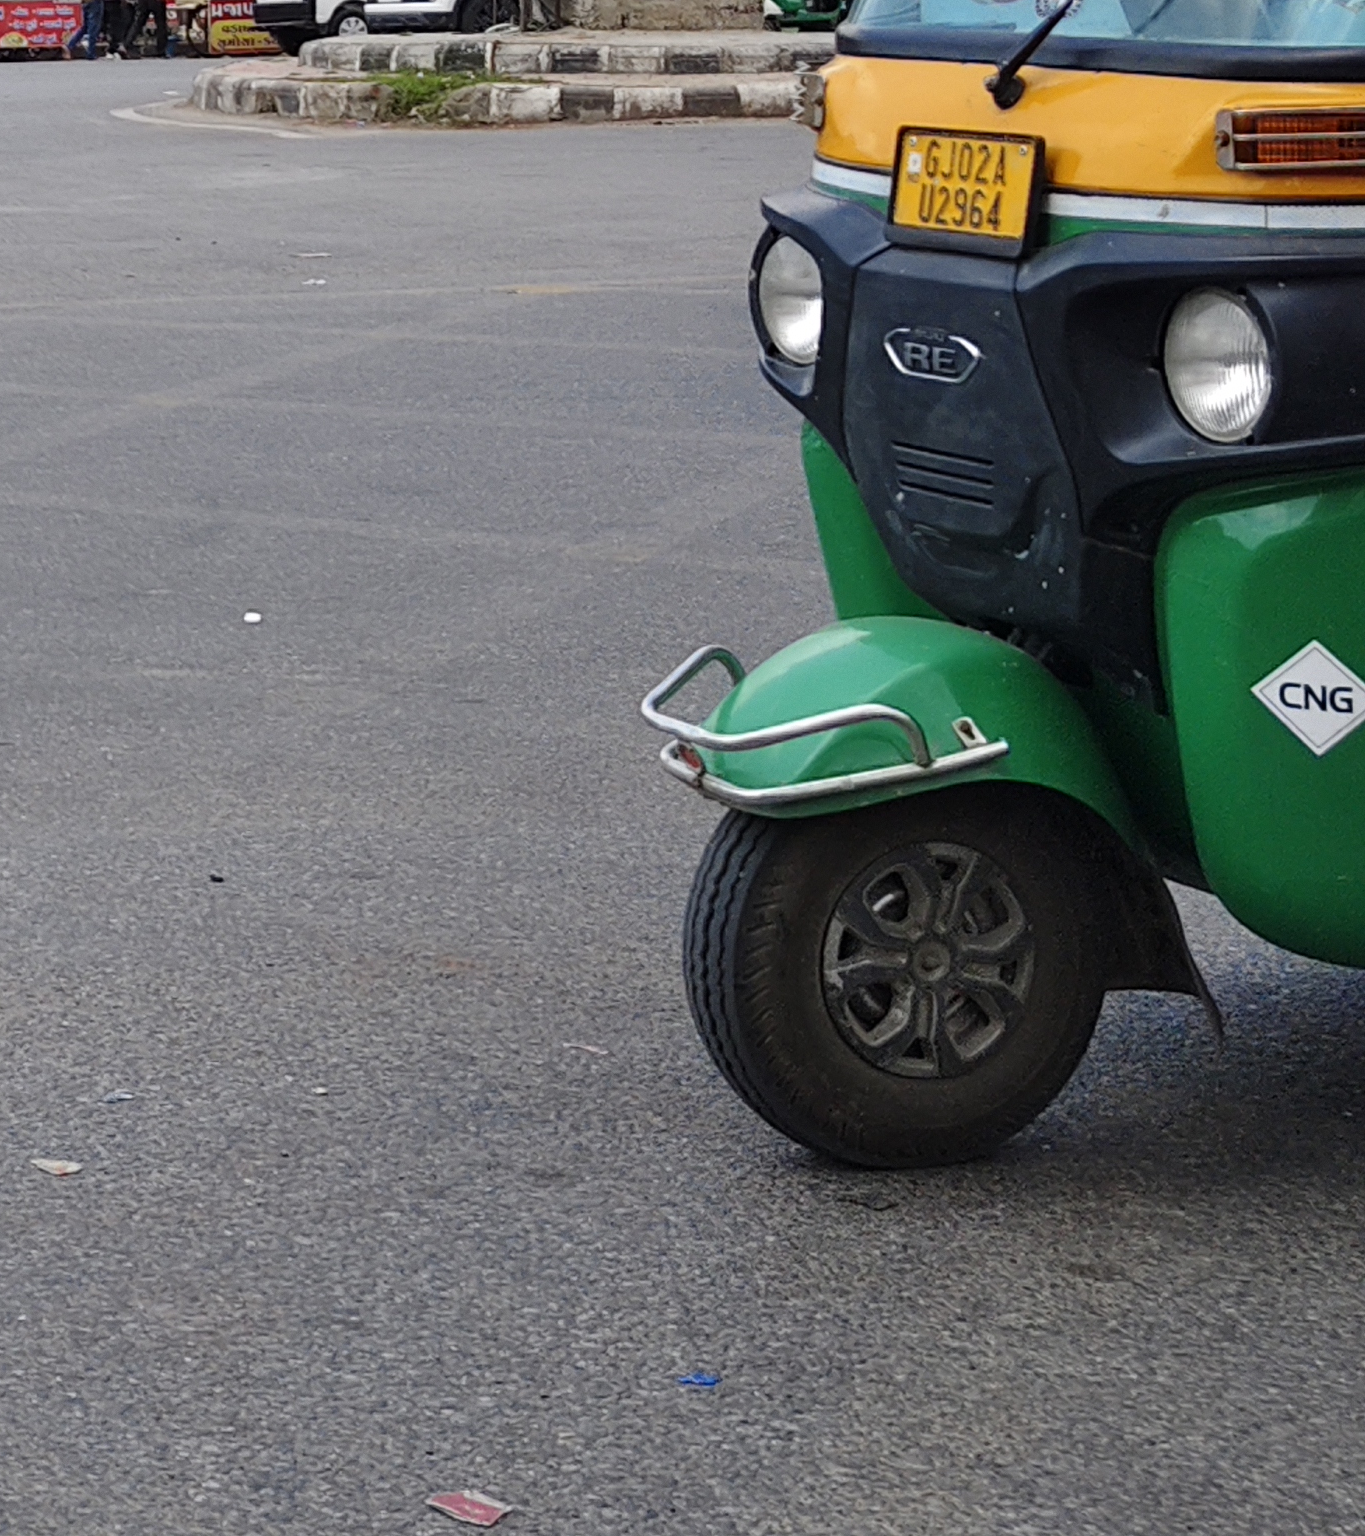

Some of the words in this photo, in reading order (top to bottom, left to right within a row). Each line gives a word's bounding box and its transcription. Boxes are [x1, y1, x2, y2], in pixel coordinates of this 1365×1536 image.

[924, 139, 1008, 188] GJ02A
[917, 181, 1004, 232] U2964
[902, 340, 958, 375] RE
[1278, 681, 1355, 715] CNG
